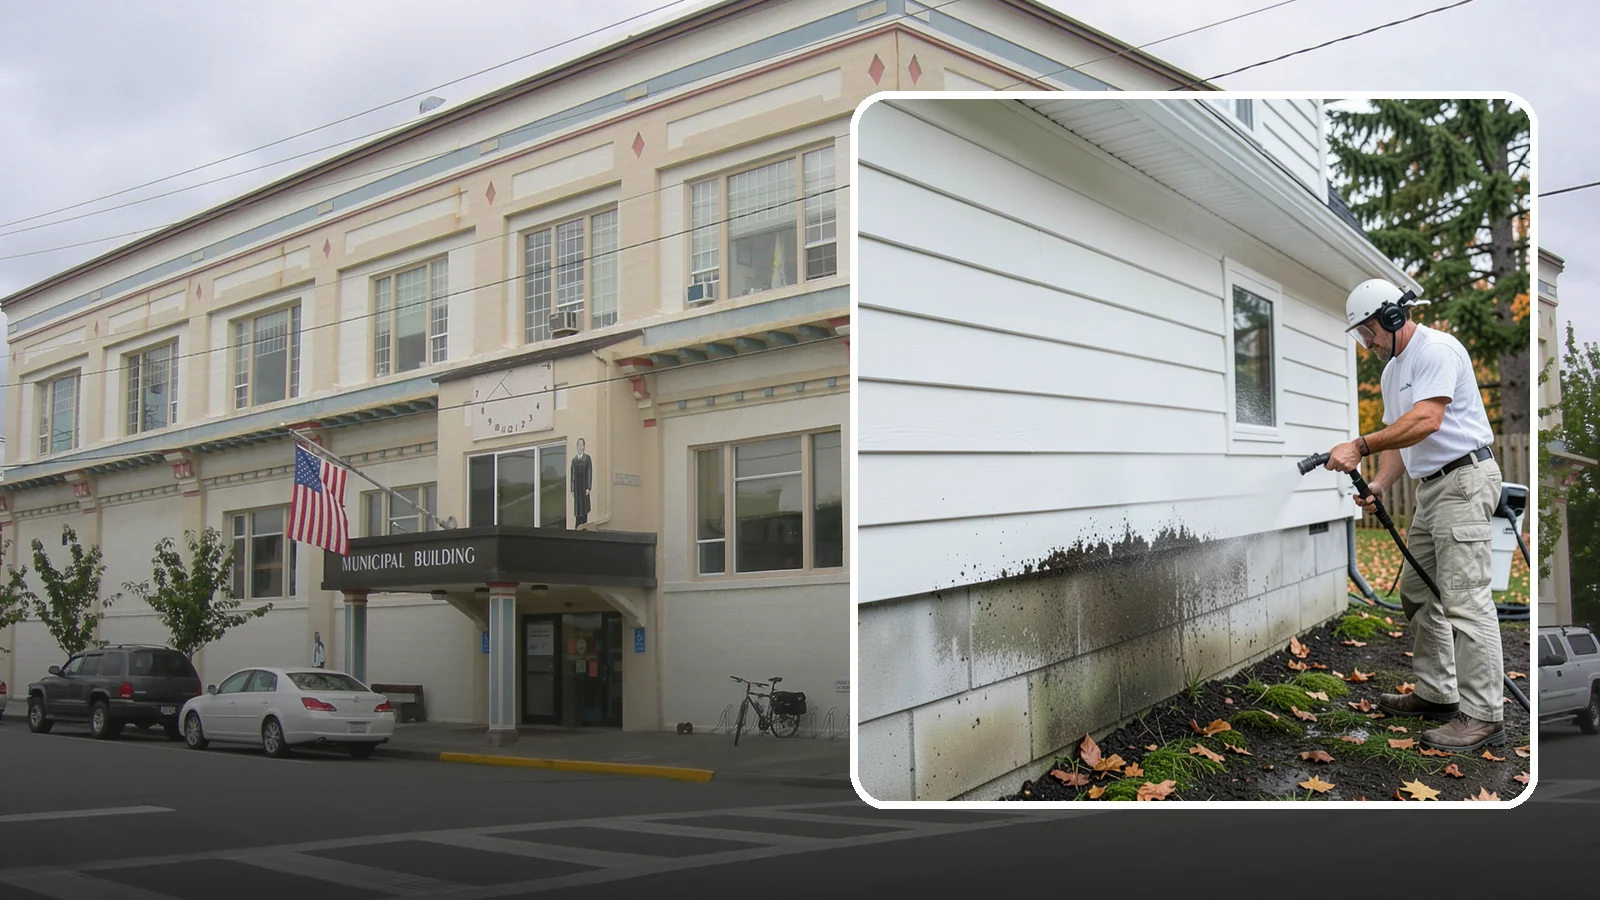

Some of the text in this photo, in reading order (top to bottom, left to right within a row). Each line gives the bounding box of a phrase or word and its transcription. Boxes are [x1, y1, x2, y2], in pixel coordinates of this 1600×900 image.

[481, 406, 485, 415] 8
[529, 414, 533, 422] 3
[536, 402, 540, 410] 4
[342, 546, 475, 572] MUNICIPAL BUILDING
